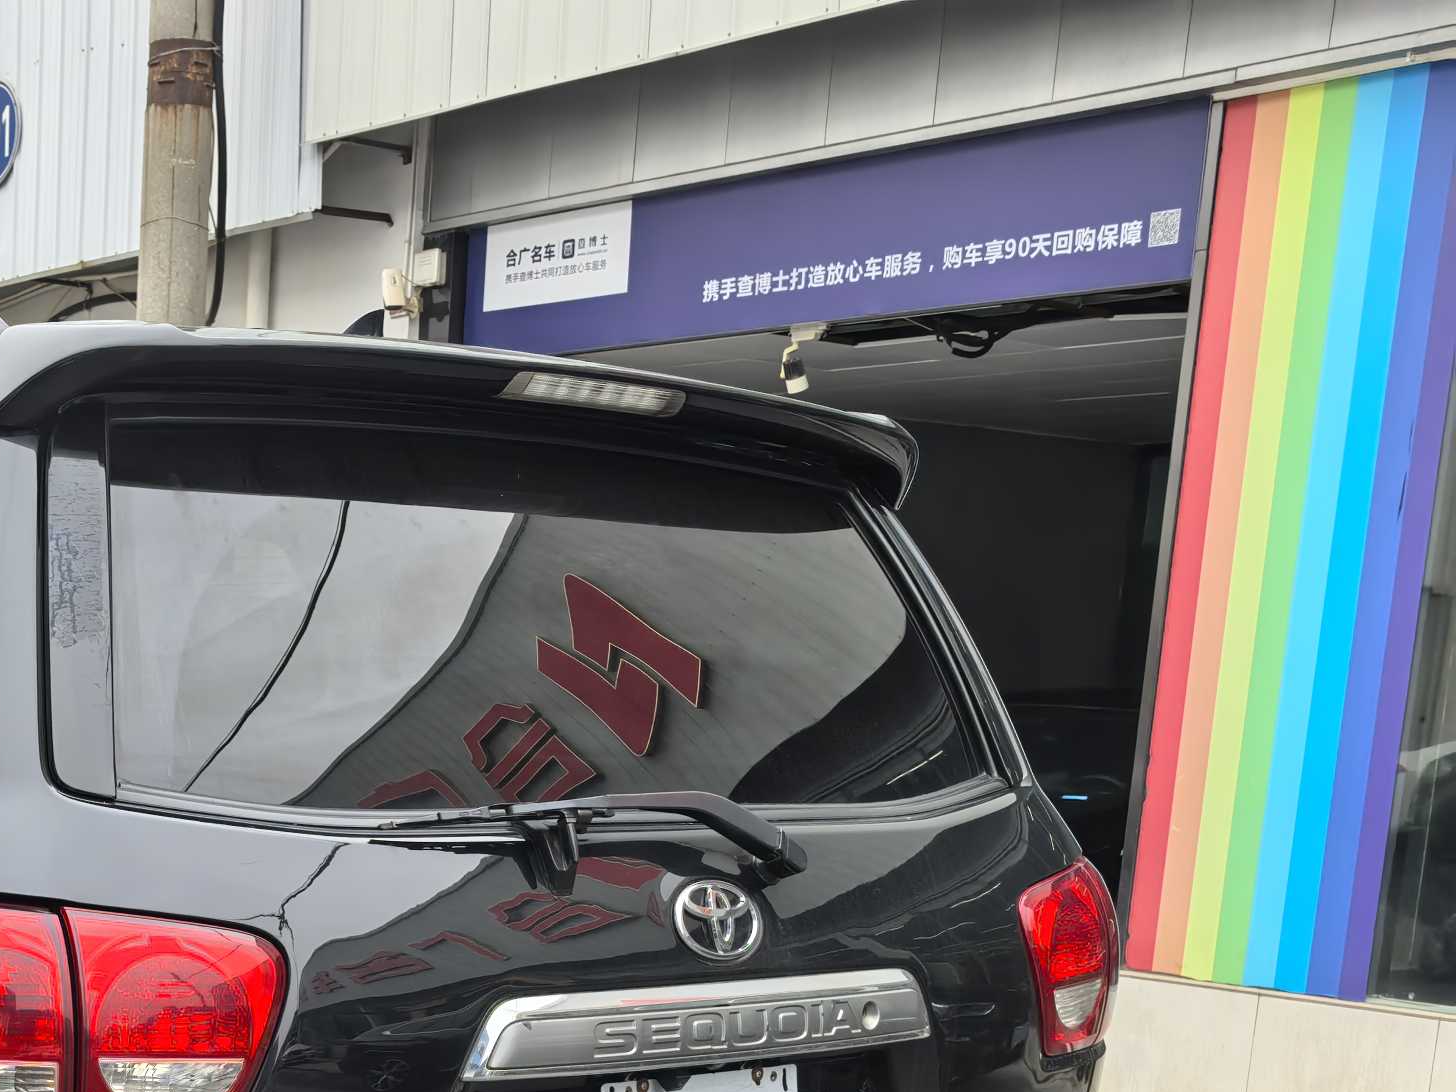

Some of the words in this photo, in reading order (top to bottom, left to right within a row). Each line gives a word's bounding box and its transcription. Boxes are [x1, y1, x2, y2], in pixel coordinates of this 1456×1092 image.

[506, 243, 556, 268] 合广名车
[593, 1000, 862, 1058] SEQUOIA
